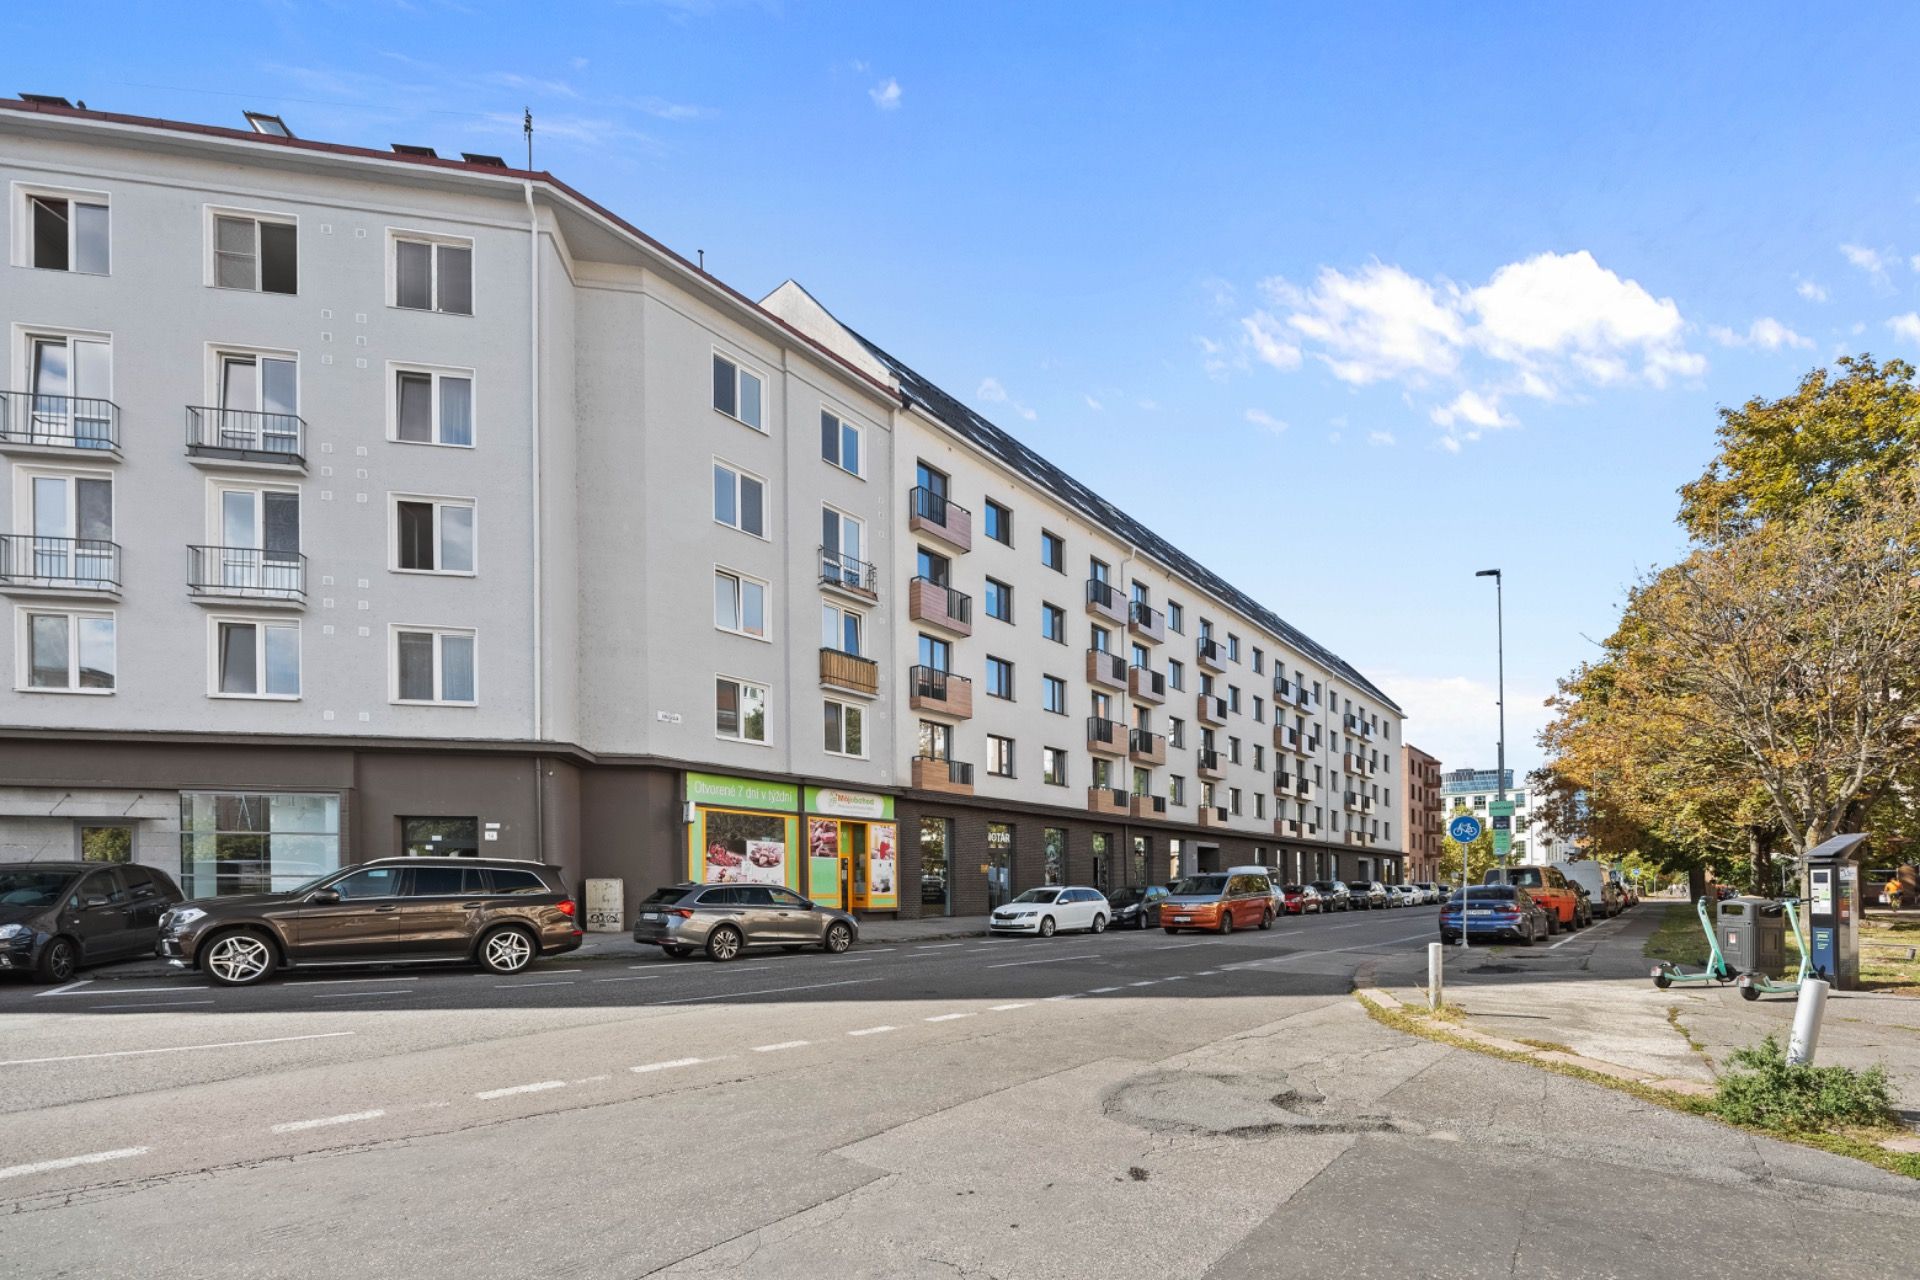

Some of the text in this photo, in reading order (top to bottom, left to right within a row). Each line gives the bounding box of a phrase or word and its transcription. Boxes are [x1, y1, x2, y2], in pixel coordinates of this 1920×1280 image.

[694, 781, 735, 797] Otvorené
[738, 785, 743, 797] 7
[746, 787, 759, 799] dni
[761, 791, 767, 799] v
